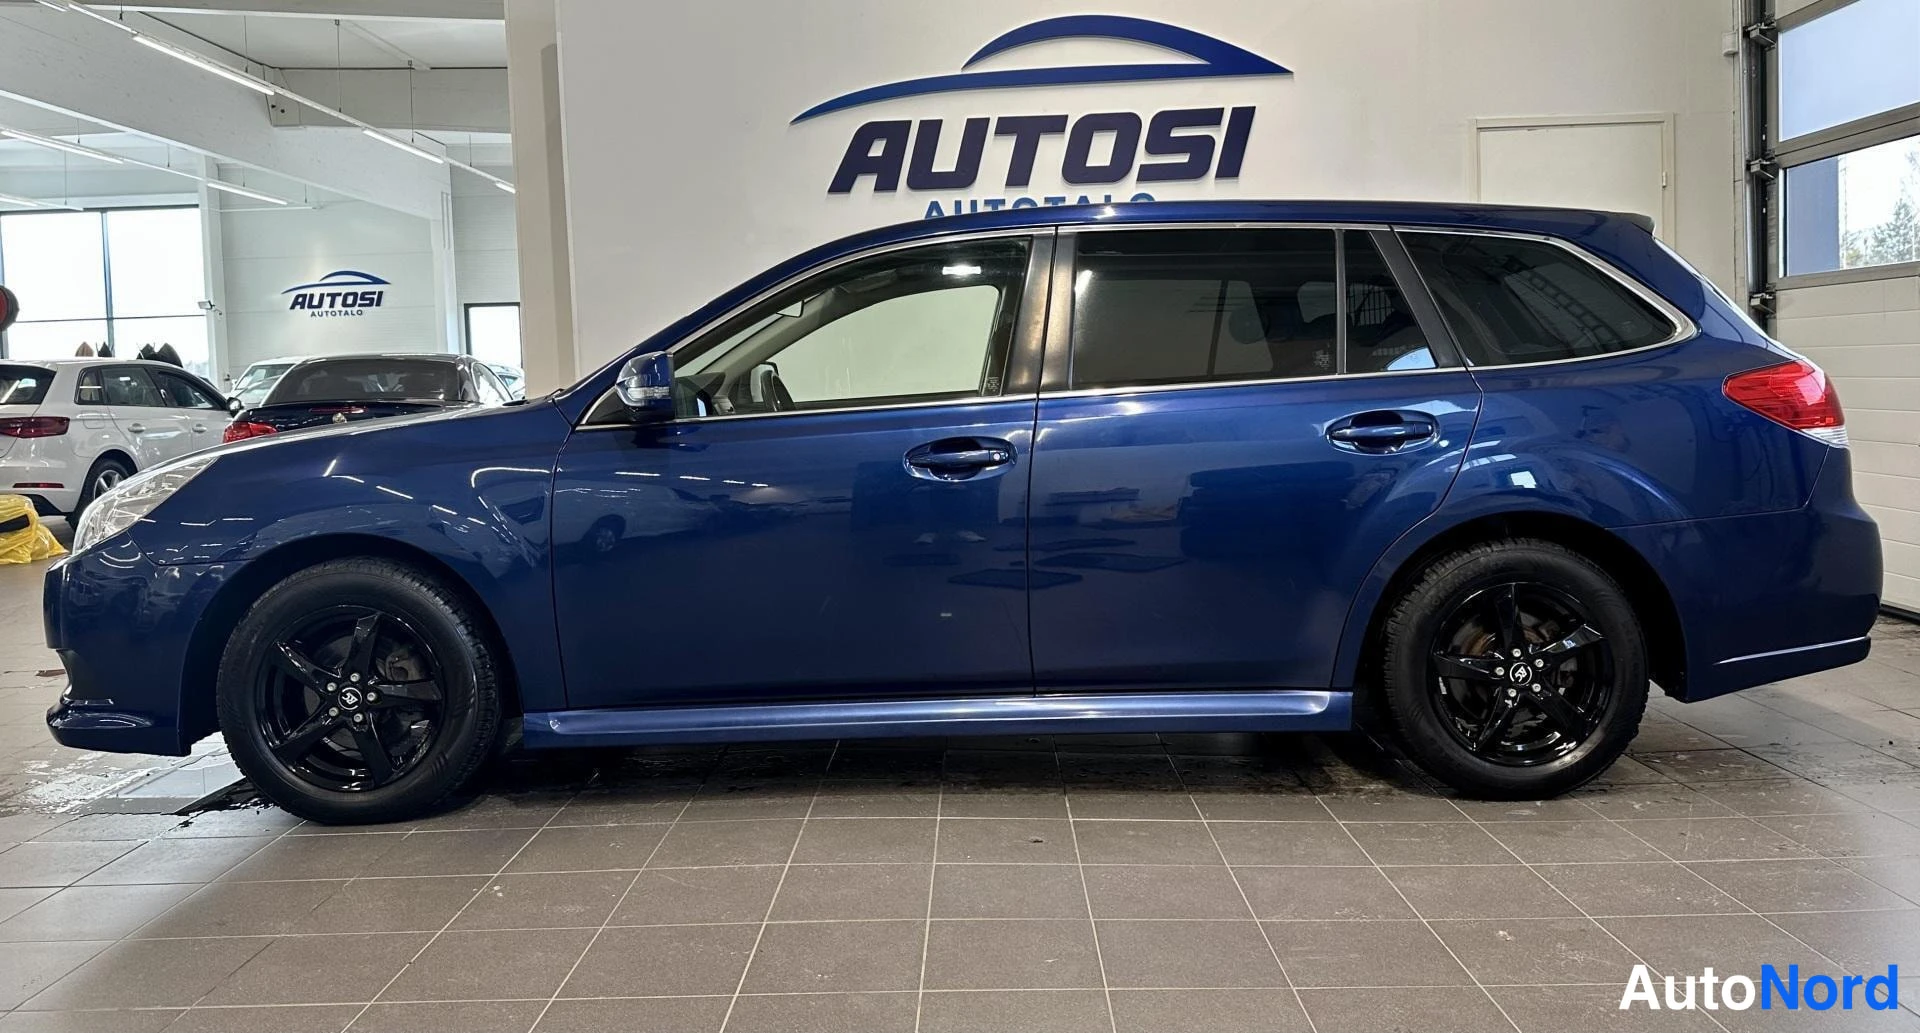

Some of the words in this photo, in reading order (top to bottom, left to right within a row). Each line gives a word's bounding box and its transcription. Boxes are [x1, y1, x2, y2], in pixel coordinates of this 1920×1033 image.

[827, 106, 1256, 193] AUTOSI
[289, 291, 384, 310] AUTOSI
[310, 309, 363, 317] AUTOTALO
